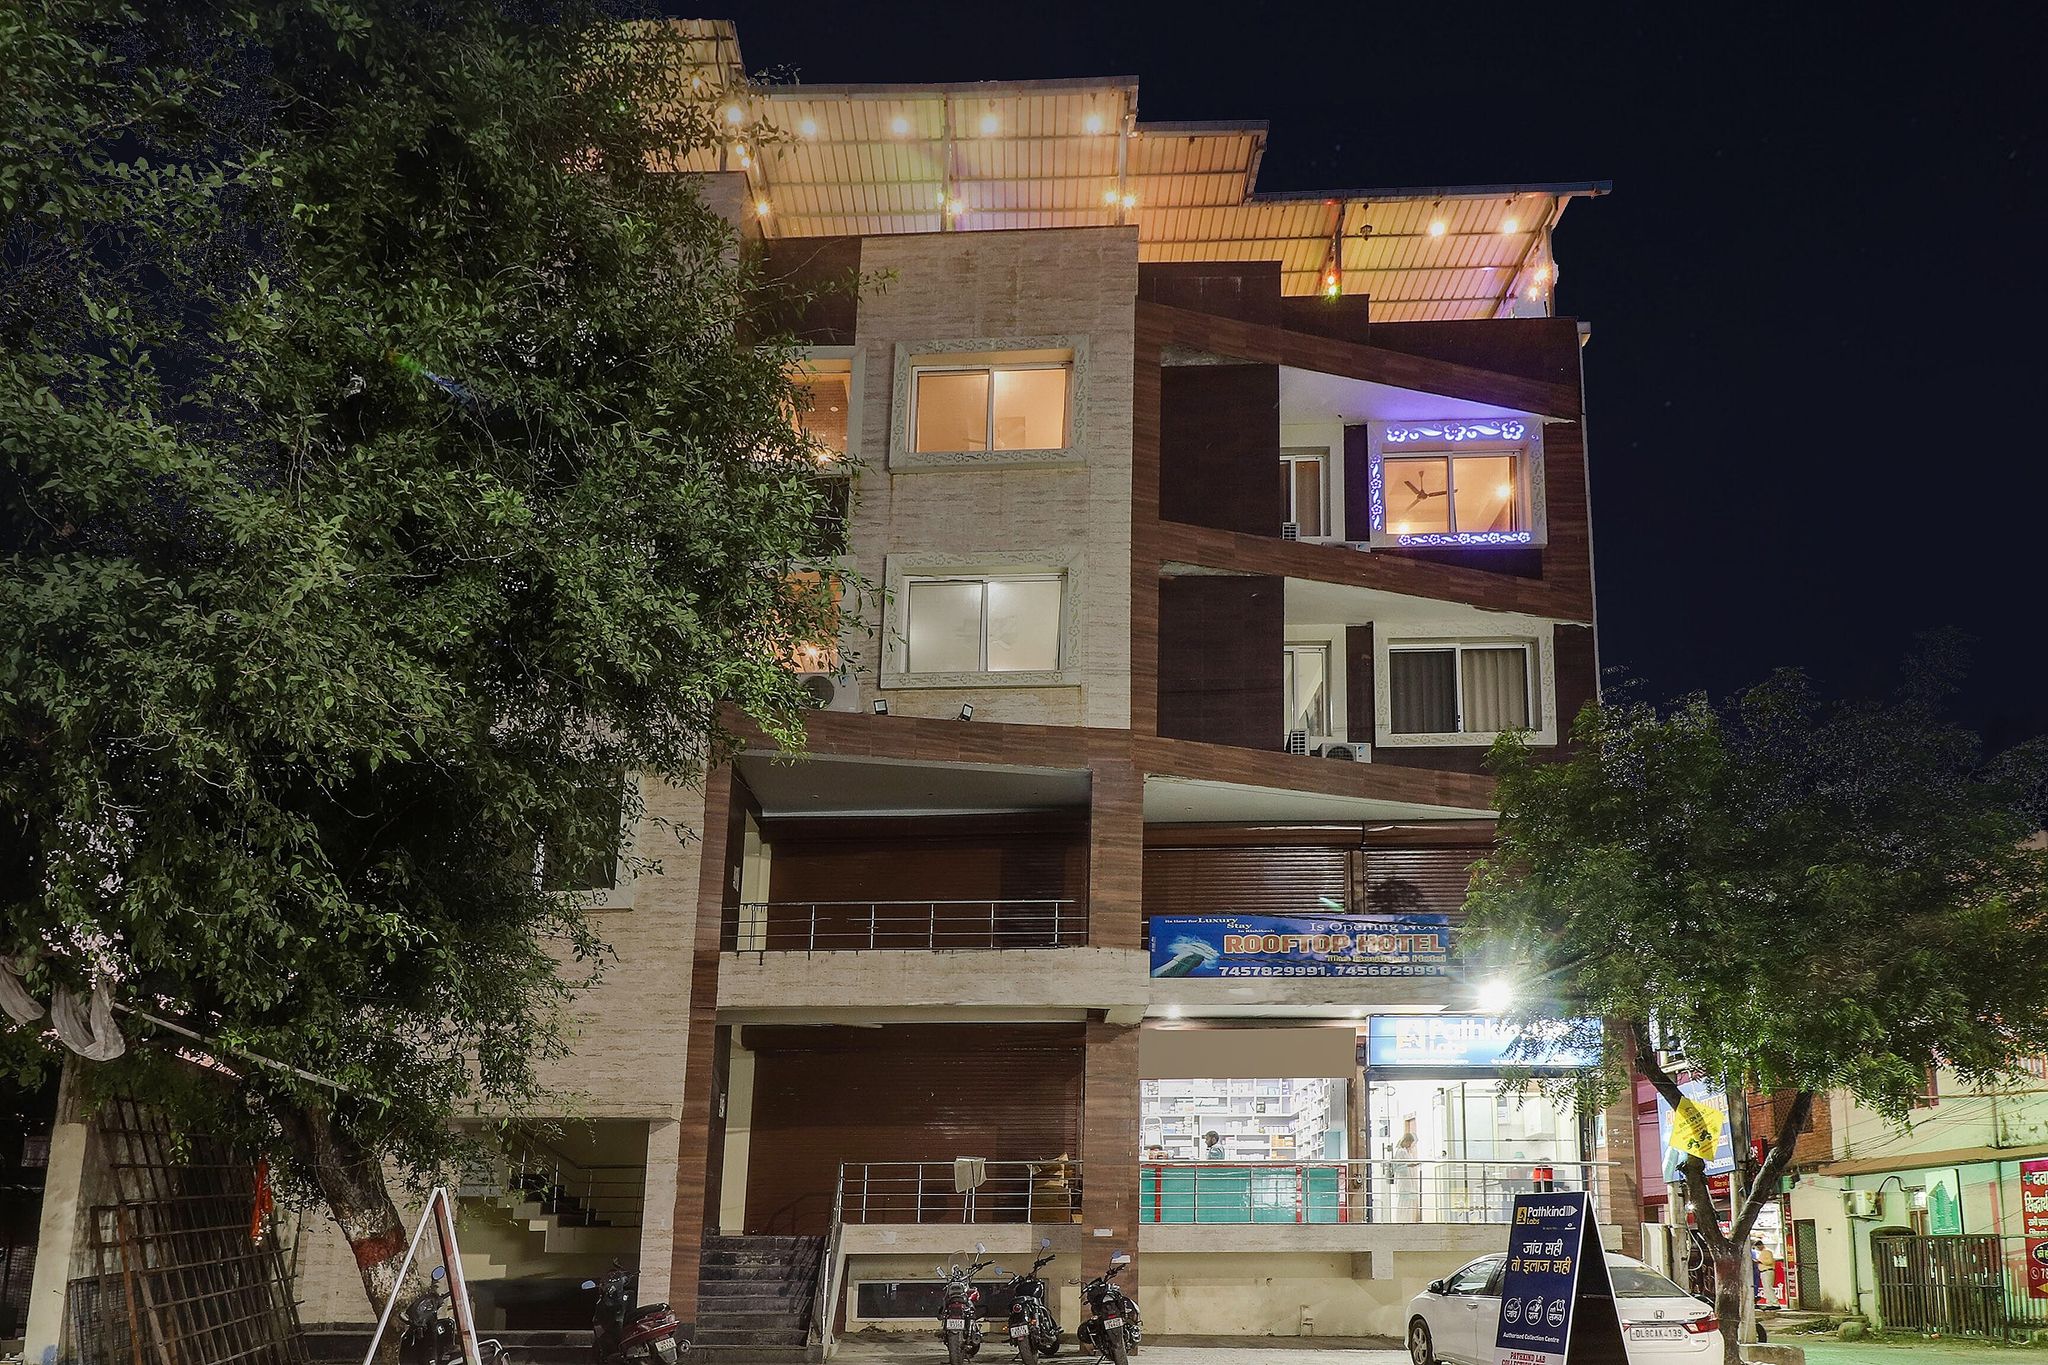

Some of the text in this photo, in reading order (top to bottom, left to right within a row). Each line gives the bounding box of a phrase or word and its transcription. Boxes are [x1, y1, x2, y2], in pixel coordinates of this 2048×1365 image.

[1198, 918, 1238, 926] Luxury
[1226, 922, 1252, 930] Stay
[1311, 923, 1325, 931] Is
[1330, 923, 1398, 932] Opening
[1224, 934, 1446, 953] ROOFTOP HOTEL
[1219, 966, 1445, 976] 7457829991, 7456829991
[1527, 1206, 1565, 1217] Pathkind
[1523, 1238, 1563, 1256] जांच सही
[1511, 1256, 1572, 1274] तो इलाज सही
[1503, 1332, 1524, 1340] Authorised
